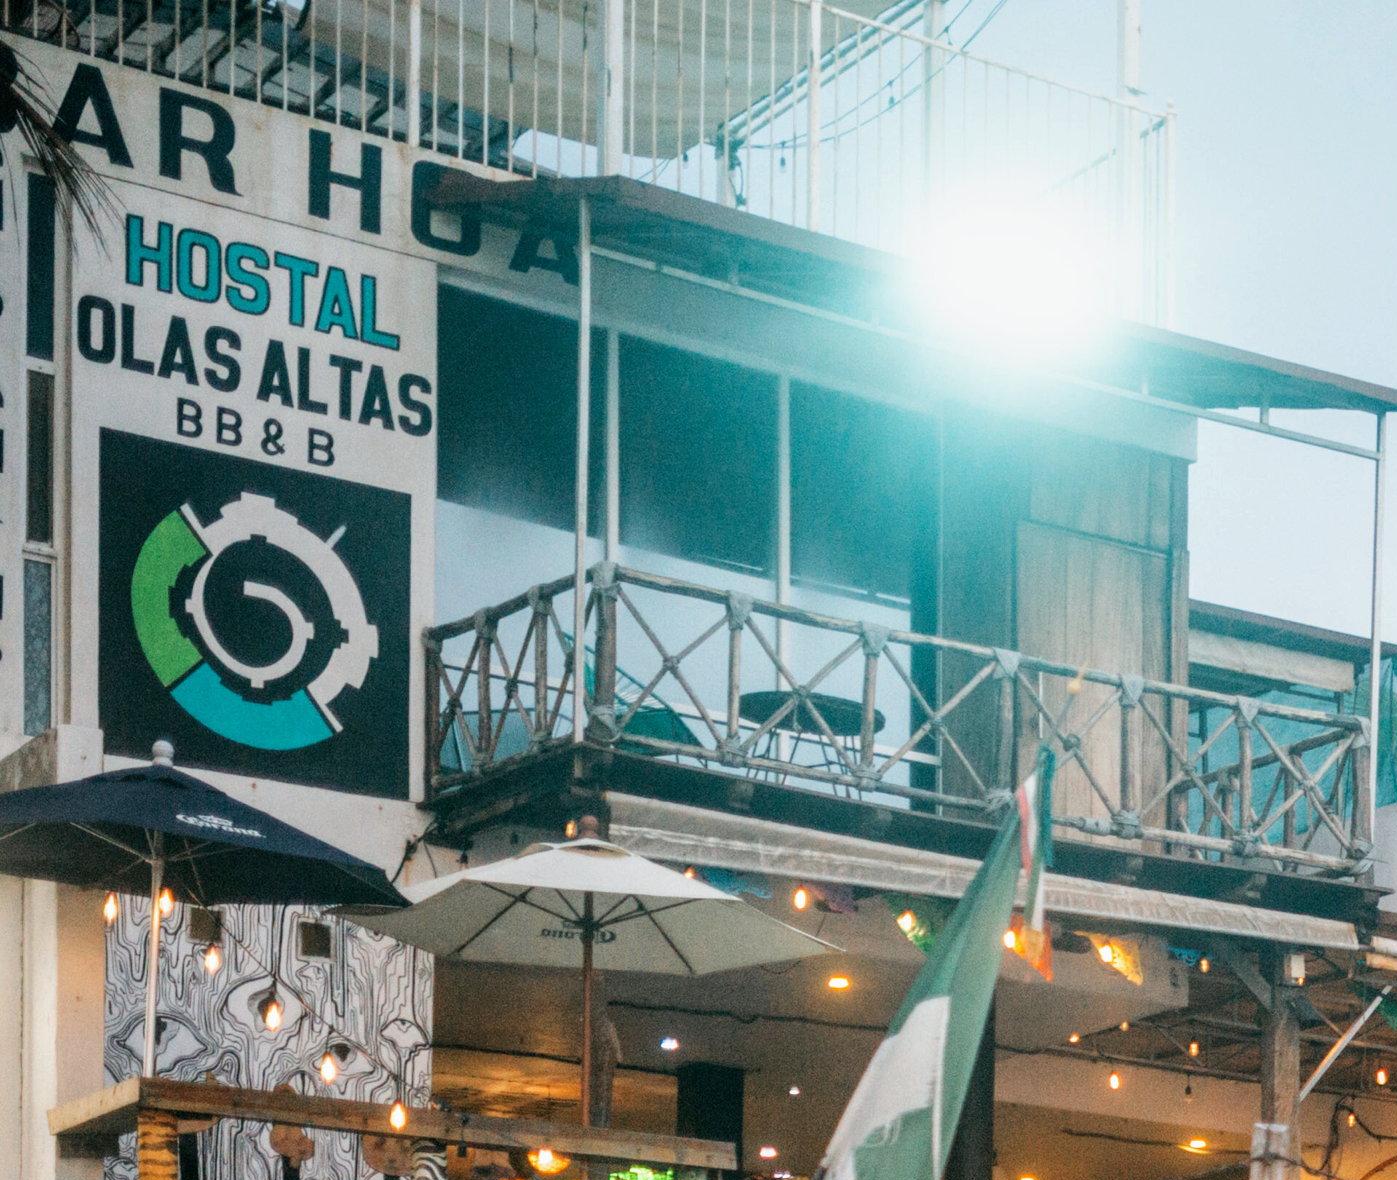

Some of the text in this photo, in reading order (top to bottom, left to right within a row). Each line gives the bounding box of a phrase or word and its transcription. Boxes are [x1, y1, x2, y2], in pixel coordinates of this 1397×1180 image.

[0, 40, 244, 197] AR
[124, 213, 400, 351] HOSTAL
[77, 294, 433, 437] OLAS ALTAS
[176, 396, 335, 467] BB & B
